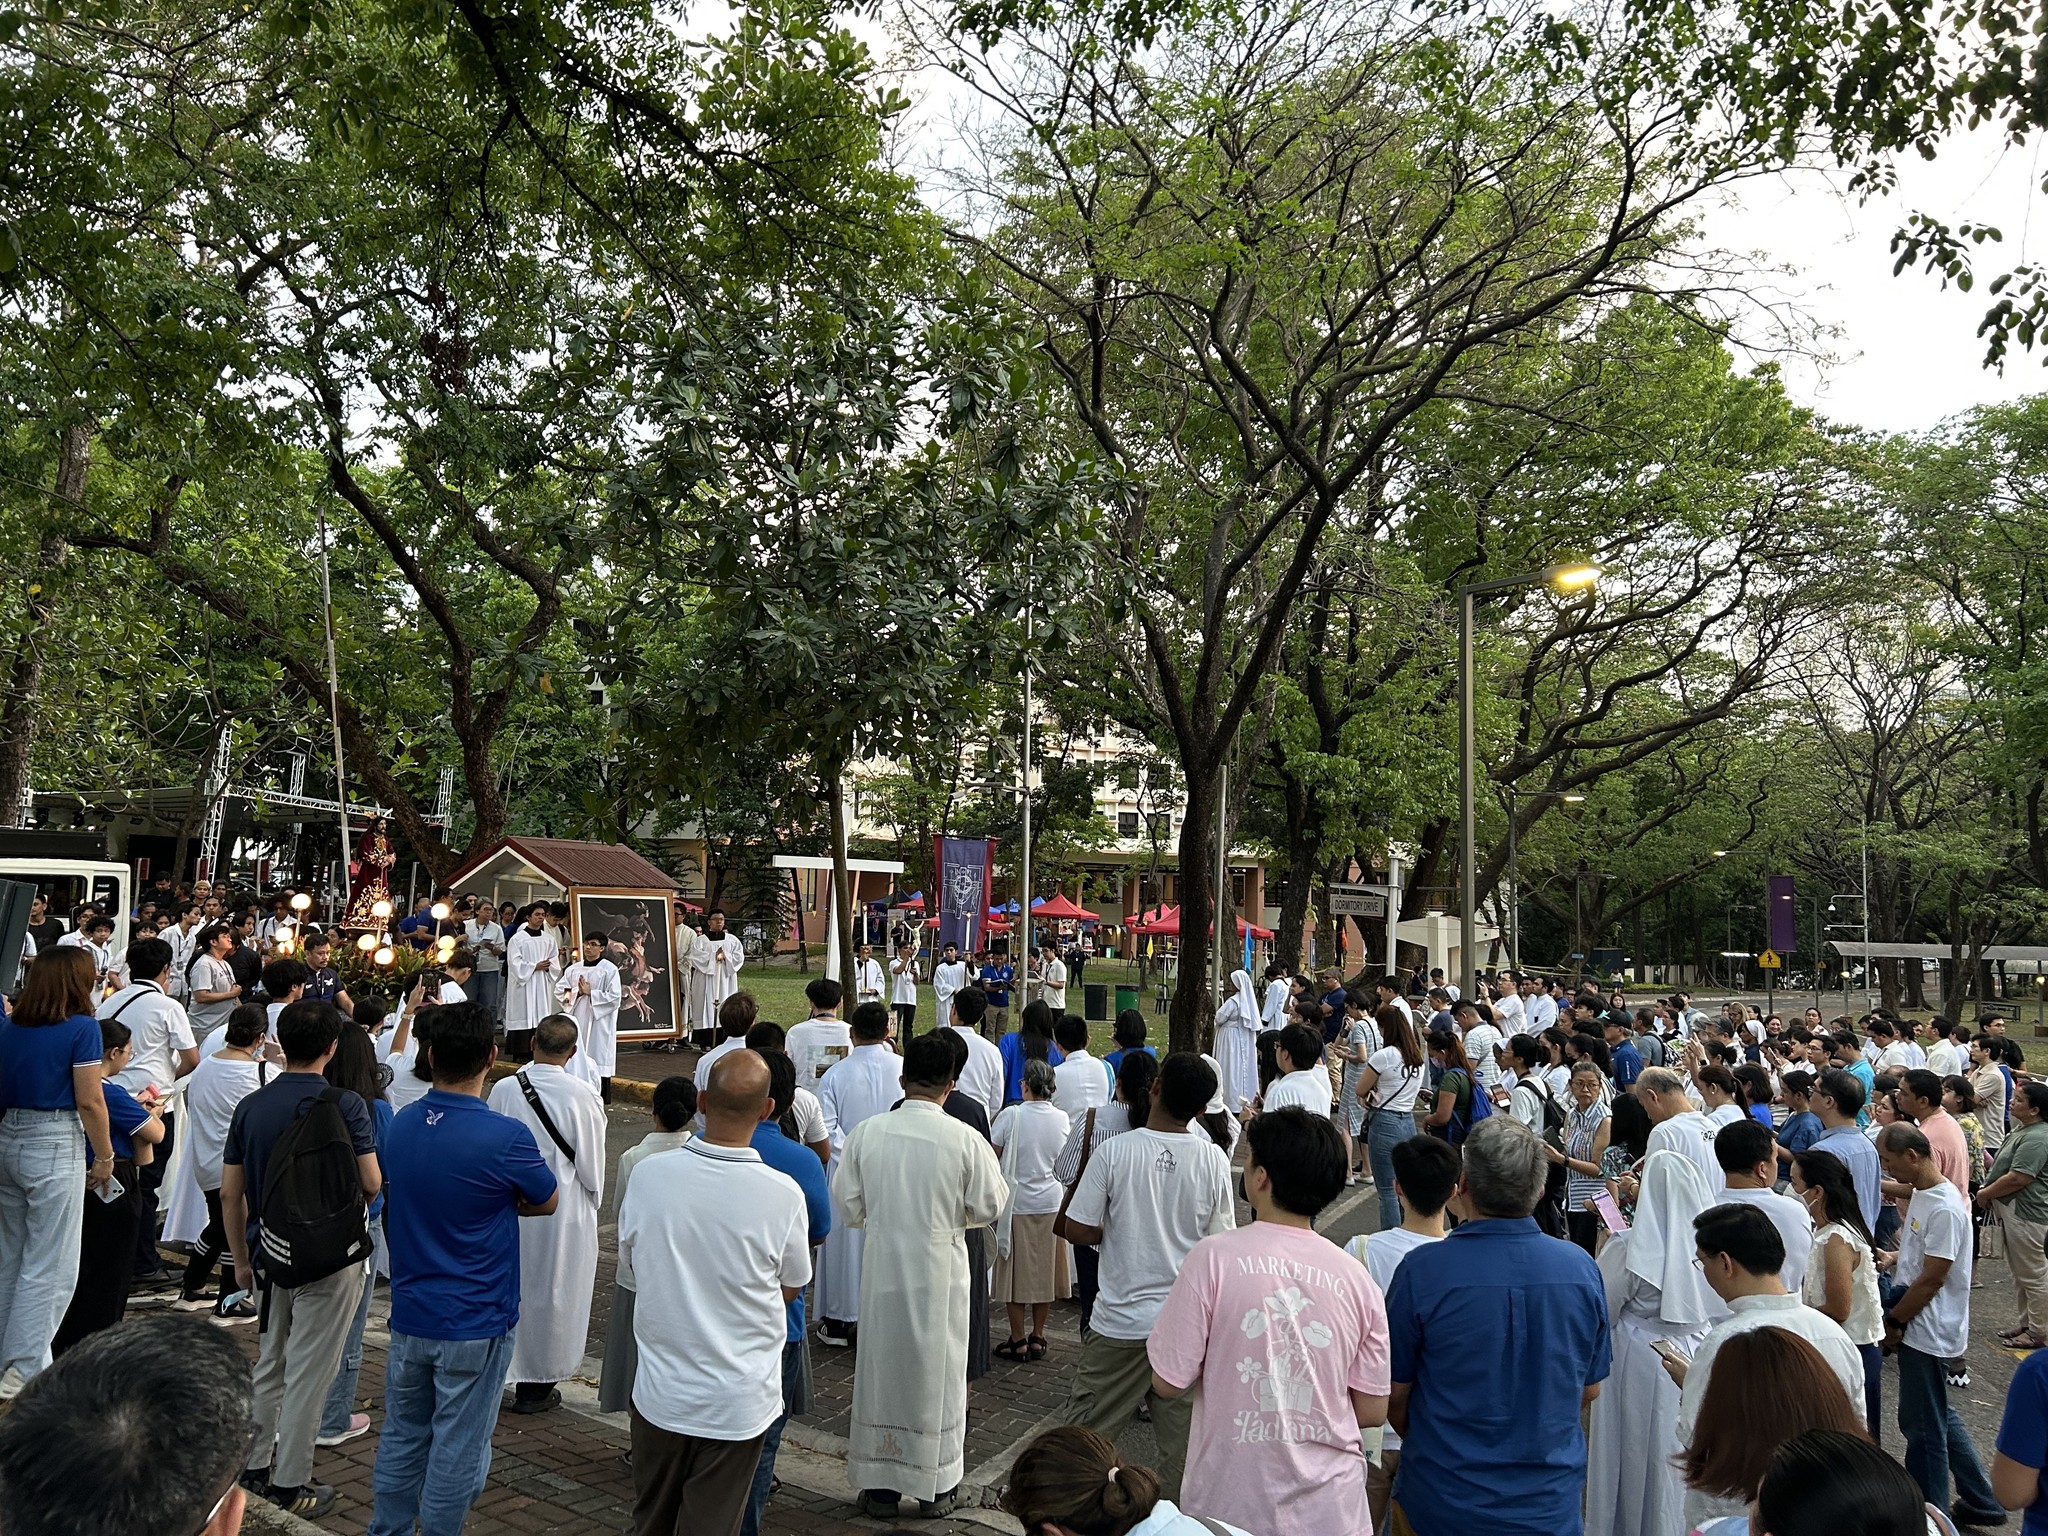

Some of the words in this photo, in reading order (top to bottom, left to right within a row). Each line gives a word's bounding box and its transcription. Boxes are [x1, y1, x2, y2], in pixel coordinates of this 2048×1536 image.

[1335, 899, 1363, 912] DORMITORY
[1363, 901, 1378, 912] DRIVE
[1401, 1065, 1420, 1079] 09
[1237, 1255, 1347, 1297] MARKETING
